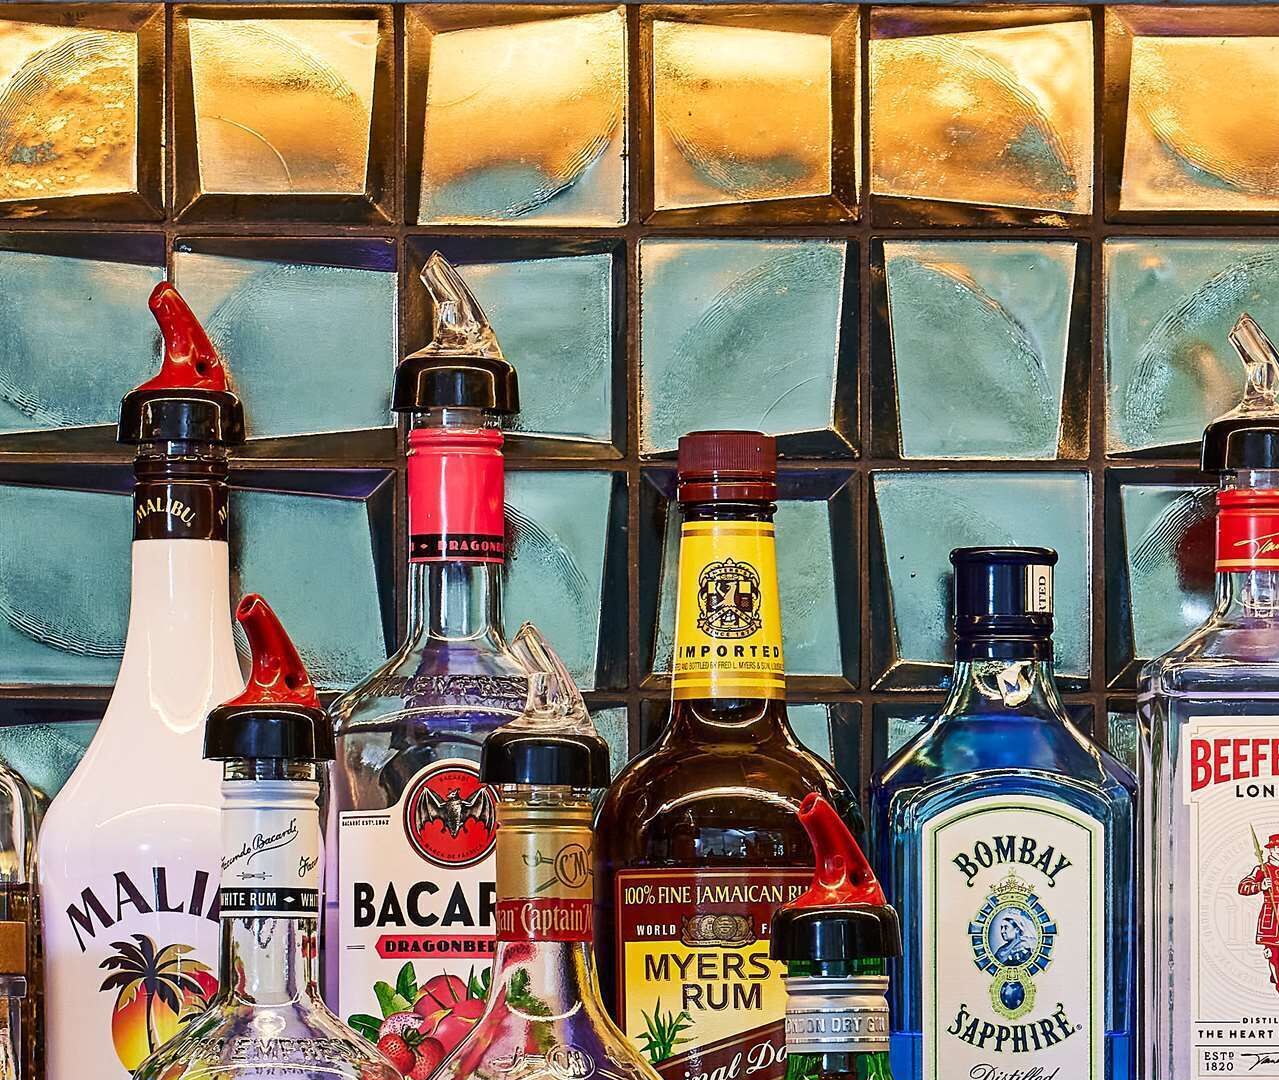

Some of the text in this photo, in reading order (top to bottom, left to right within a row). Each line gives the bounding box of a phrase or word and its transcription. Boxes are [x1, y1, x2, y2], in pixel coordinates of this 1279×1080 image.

[137, 497, 196, 523] MALIBU
[680, 645, 779, 658] IMPORTED
[953, 835, 1072, 887] BOMBAY
[354, 881, 496, 927] BACAR
[625, 886, 783, 905] 100% FINE JAMAICAN
[520, 904, 584, 936] Captain
[645, 953, 771, 981] MYERS
[682, 984, 763, 1011] RUM
[947, 1003, 1076, 1052] SAPPHIRE
[1199, 1030, 1224, 1039] THE
[1230, 1030, 1273, 1038] HEART
